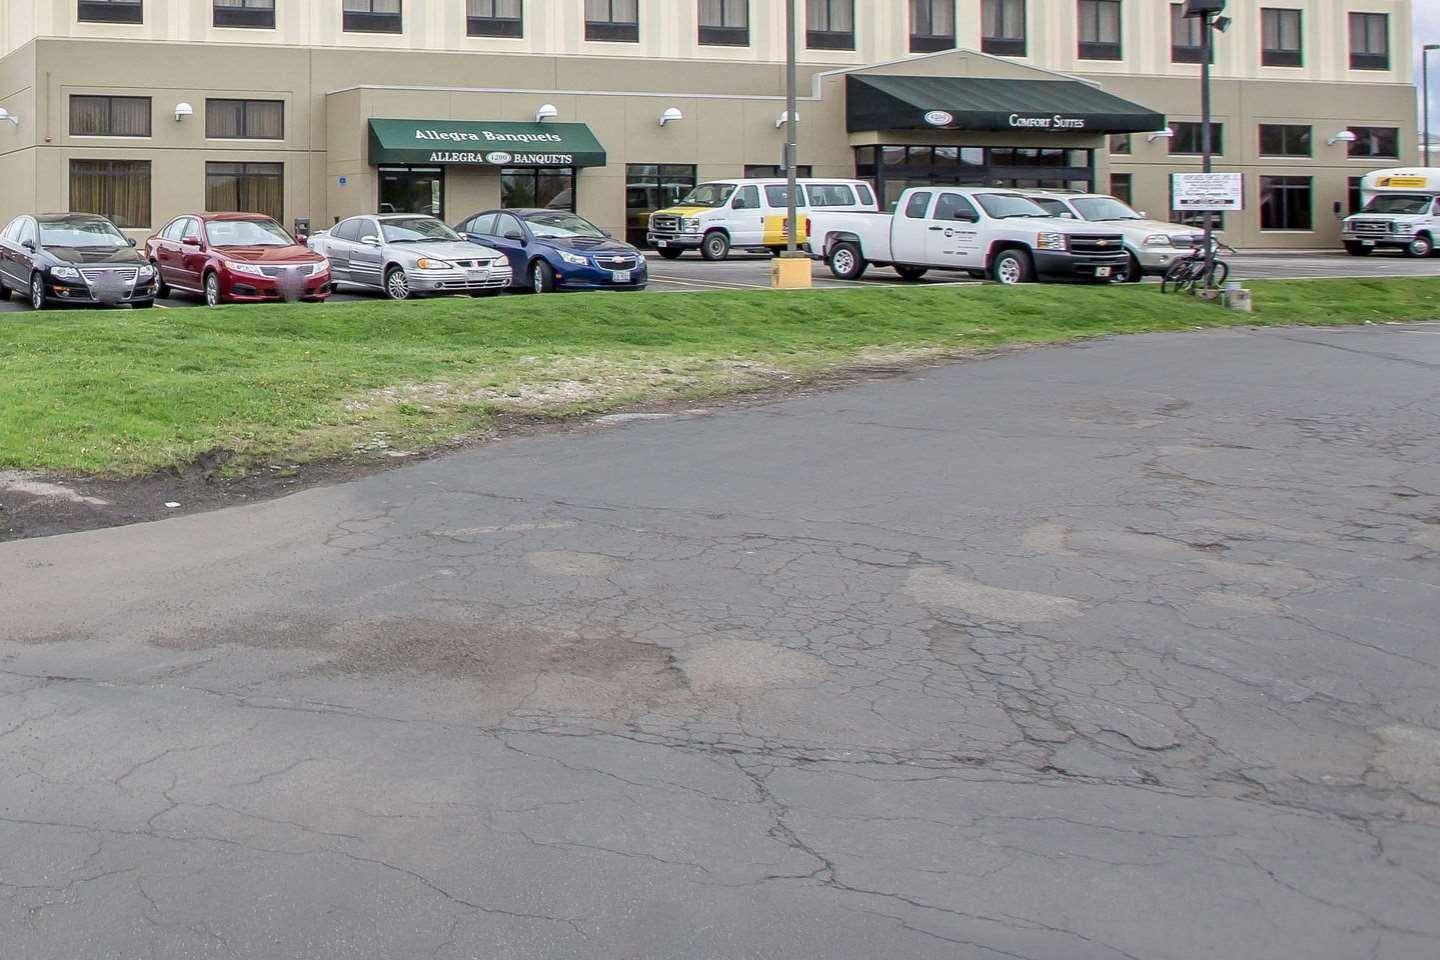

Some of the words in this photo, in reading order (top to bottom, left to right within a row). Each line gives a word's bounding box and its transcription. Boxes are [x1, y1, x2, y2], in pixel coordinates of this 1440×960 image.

[1009, 113, 1051, 127] COMFORT
[1053, 115, 1084, 128] SUITES
[415, 130, 479, 142] Allegra
[482, 130, 562, 142] Banquets
[430, 152, 482, 162] ALLEGRA
[515, 154, 572, 164] BANQUETS
